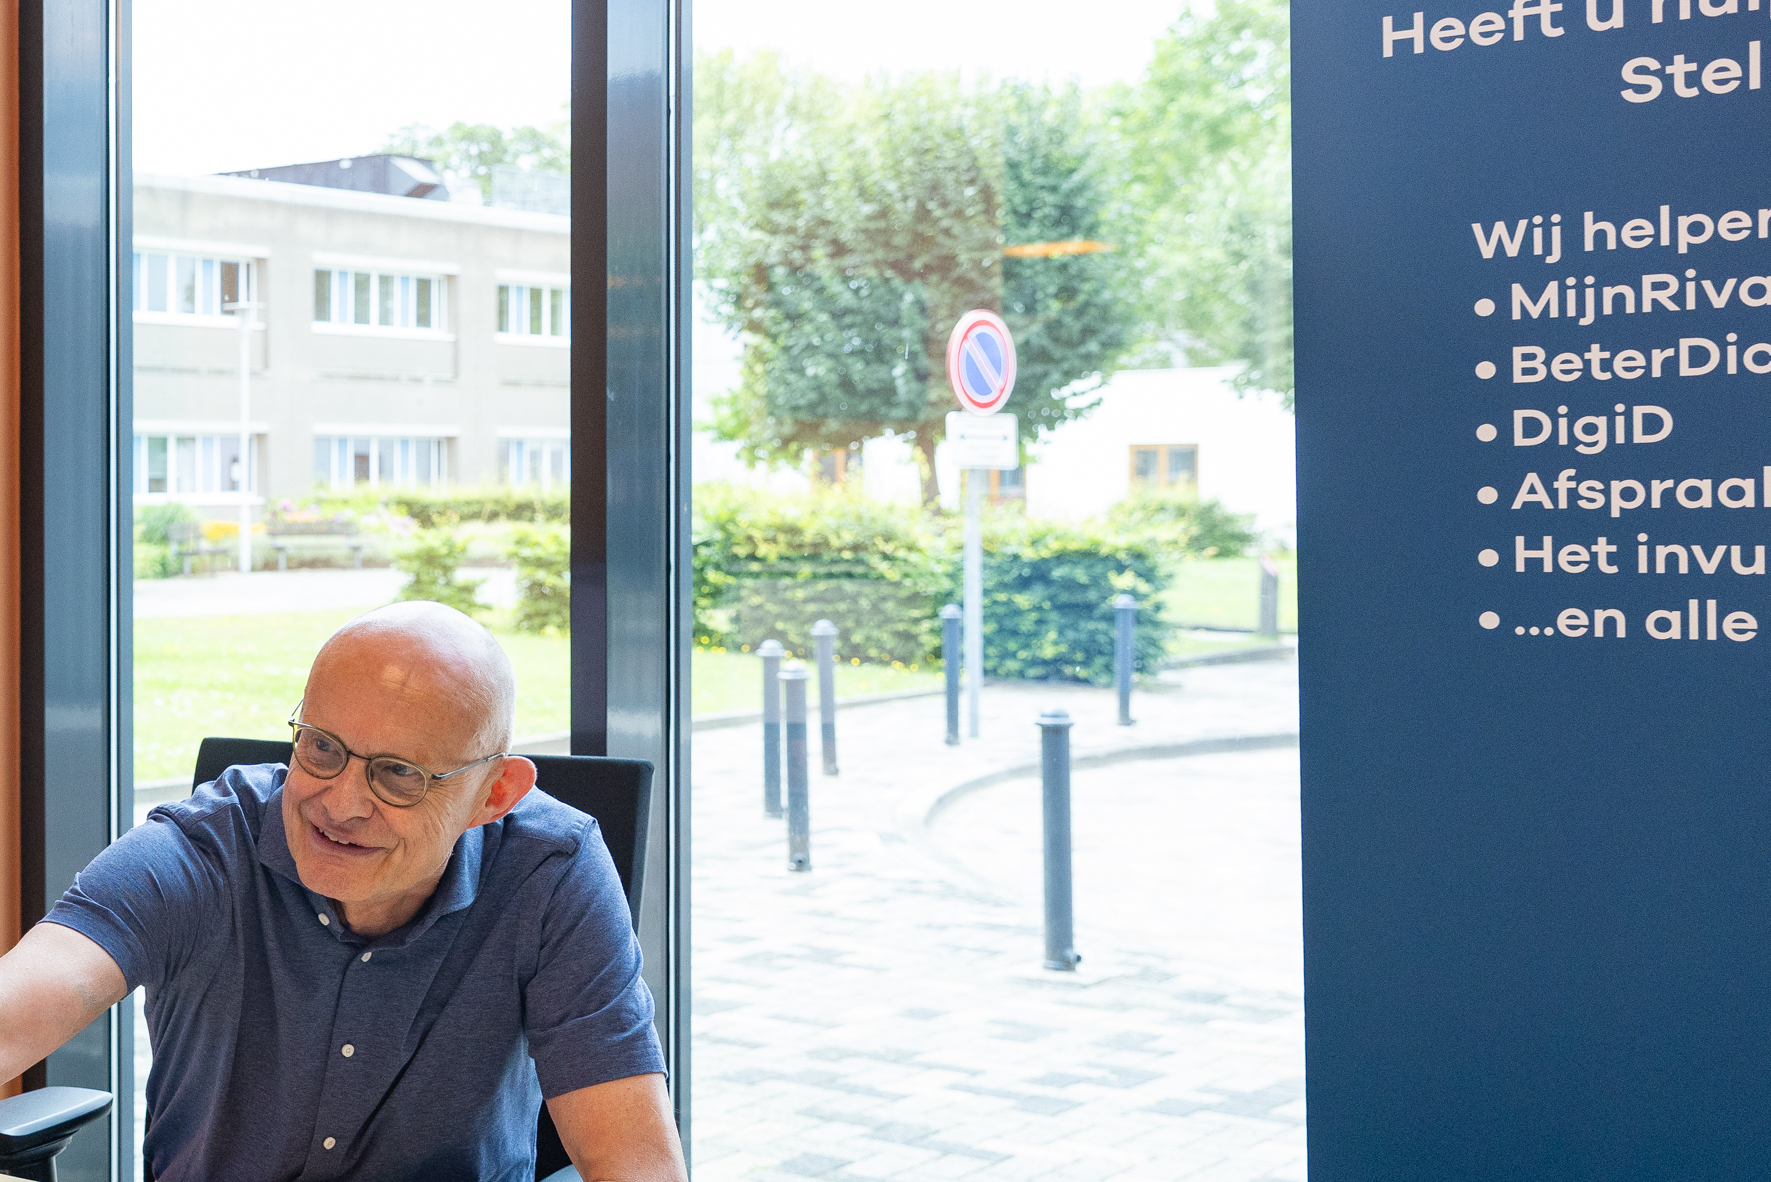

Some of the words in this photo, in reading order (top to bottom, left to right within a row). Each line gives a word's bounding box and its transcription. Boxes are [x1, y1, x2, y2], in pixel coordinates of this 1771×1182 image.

[1382, 0, 1565, 58] Heeft
[1585, 0, 1624, 32] u
[1620, 41, 1761, 103] Stel
[1471, 214, 1562, 263] Wij
[1511, 269, 1771, 326] MijnRiva
[1513, 403, 1674, 455] DigiD
[1511, 466, 1771, 518] Afspraa
[1515, 535, 1620, 574] Het
[1637, 532, 1766, 575] invu
[1645, 598, 1759, 642] alle
